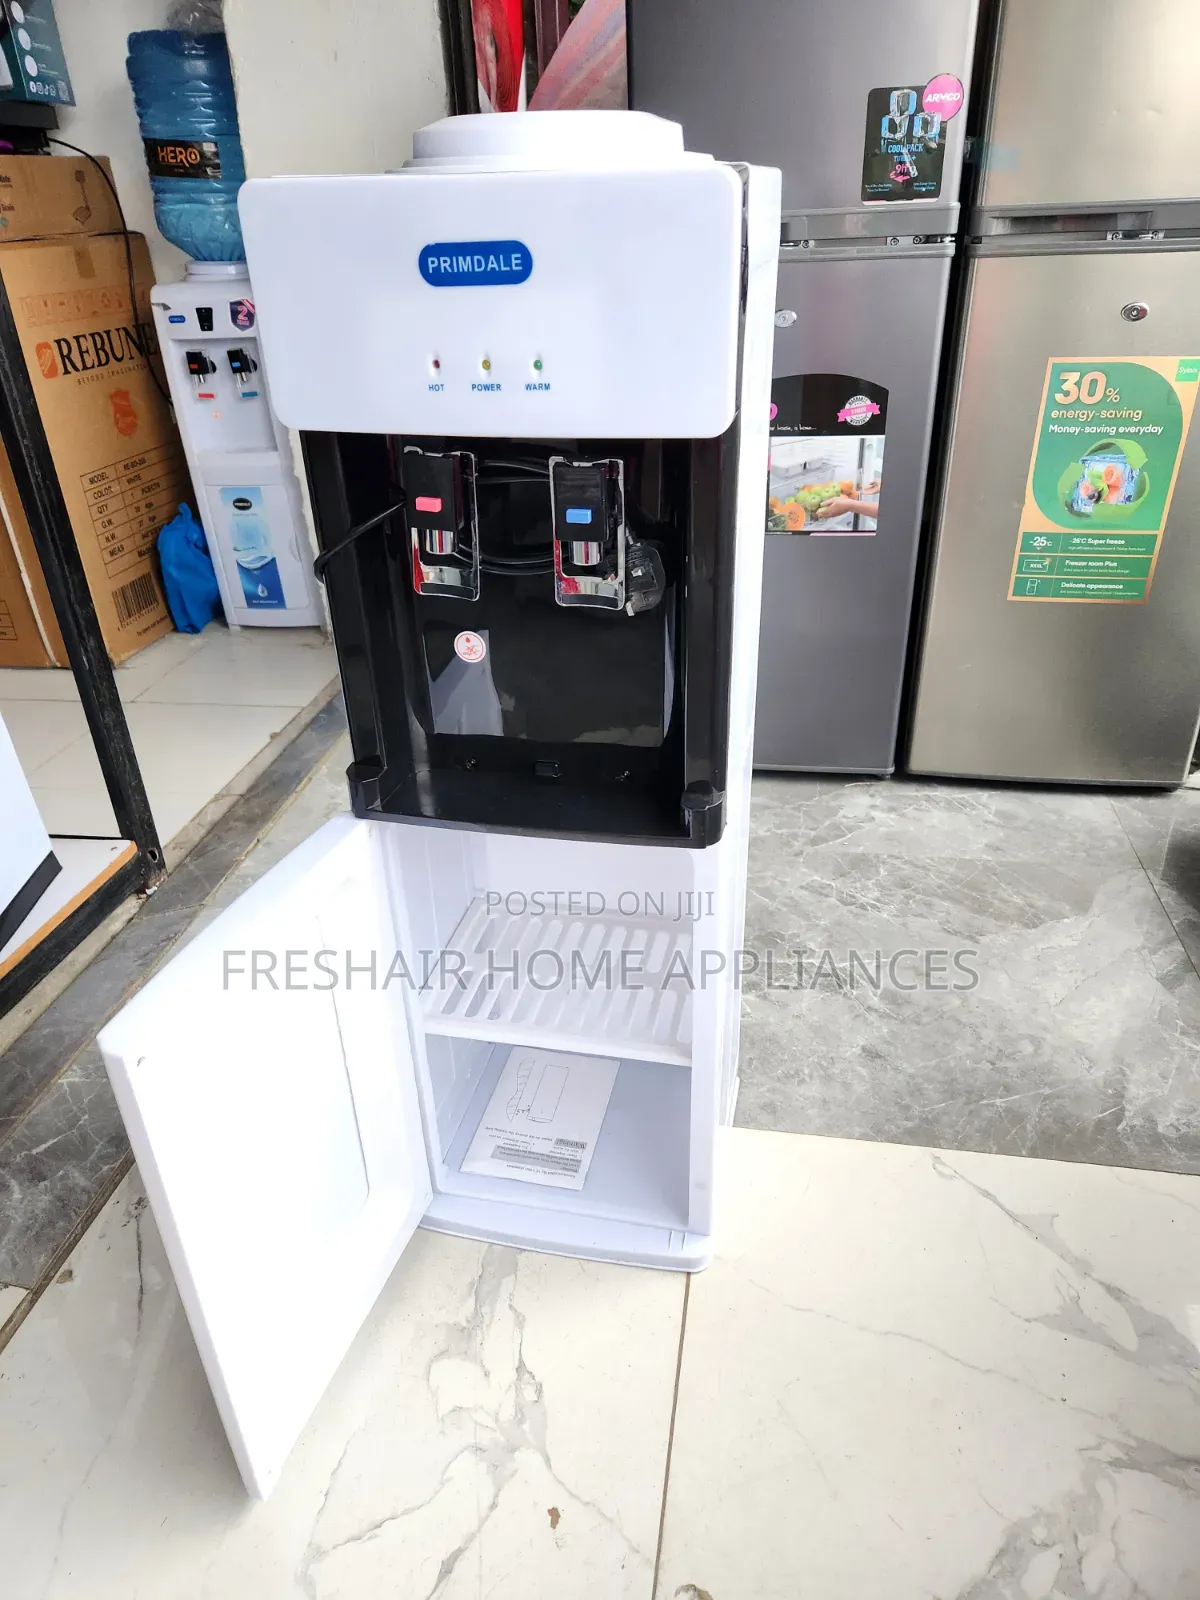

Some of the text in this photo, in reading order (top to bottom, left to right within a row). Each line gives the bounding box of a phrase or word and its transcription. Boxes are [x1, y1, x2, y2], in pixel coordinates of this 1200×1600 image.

[907, 143, 924, 152] PACK
[158, 146, 200, 167] HERO
[427, 253, 523, 274] PRIMDALE
[237, 305, 249, 320] 2
[54, 323, 158, 376] REBUNE
[428, 383, 445, 392] HOT
[471, 383, 502, 391] POWER
[525, 383, 551, 391] WARM
[1054, 371, 1121, 405] 30%
[1051, 407, 1143, 422] energy-saving
[1048, 424, 1164, 436] Money-saving everyday
[89, 471, 109, 486] MODEL
[93, 486, 113, 500] COLOR
[97, 503, 108, 514] QTY
[1087, 538, 1106, 546] Super
[109, 544, 125, 557] MEAS
